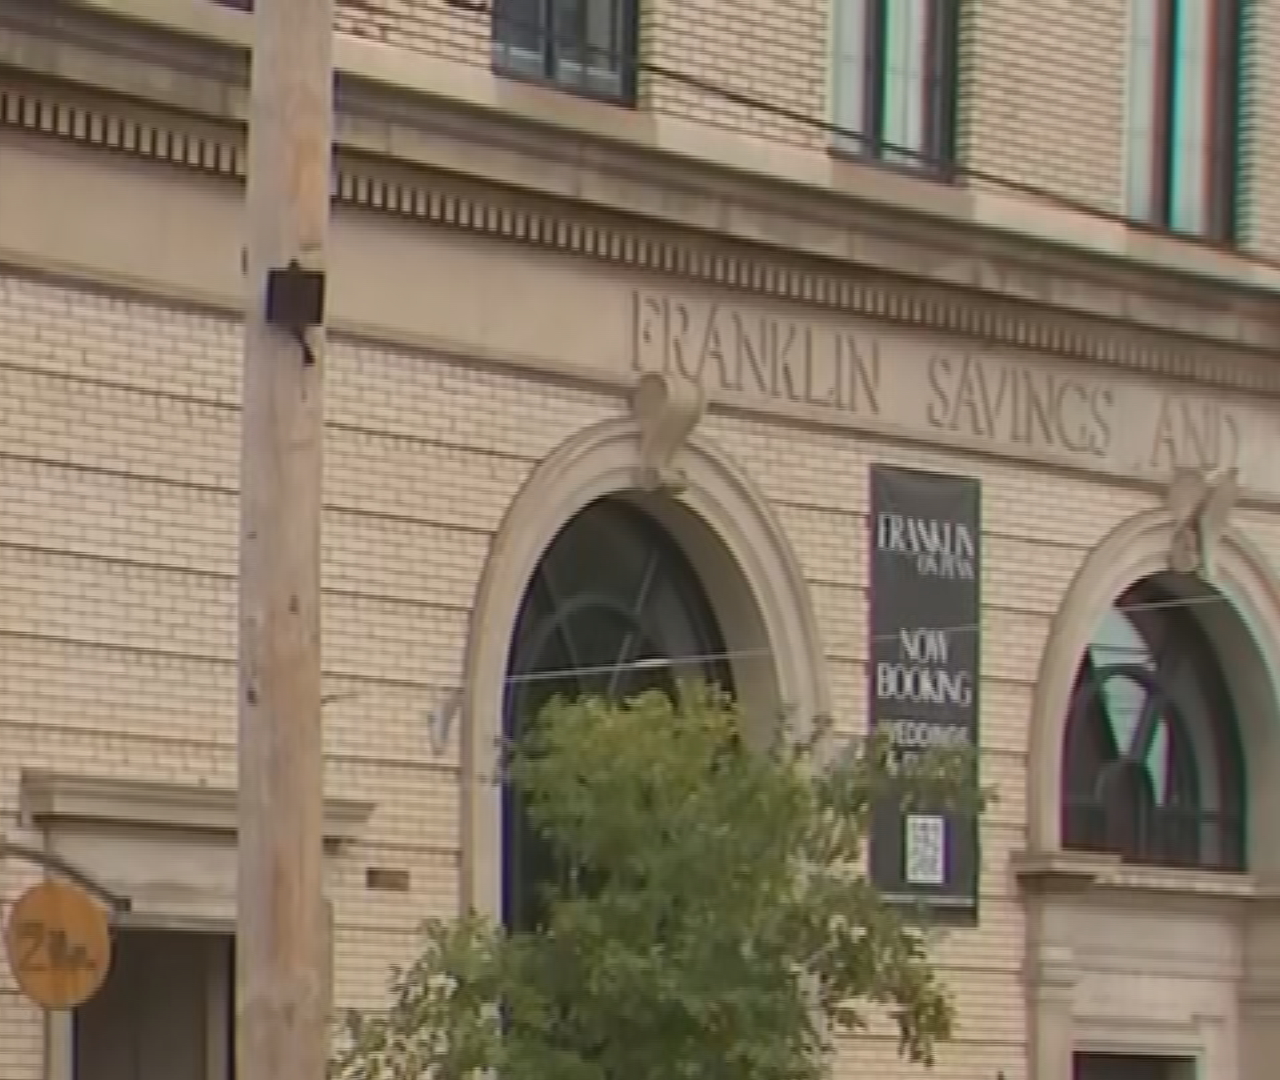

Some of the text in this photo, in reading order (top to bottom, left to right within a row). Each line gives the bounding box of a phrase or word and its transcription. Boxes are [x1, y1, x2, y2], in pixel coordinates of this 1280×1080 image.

[630, 291, 1242, 473] FRANKLIN SAVINGS AND
[877, 512, 975, 559] FRANKLIN
[899, 627, 948, 664] NOW
[877, 662, 972, 707] BOOKING
